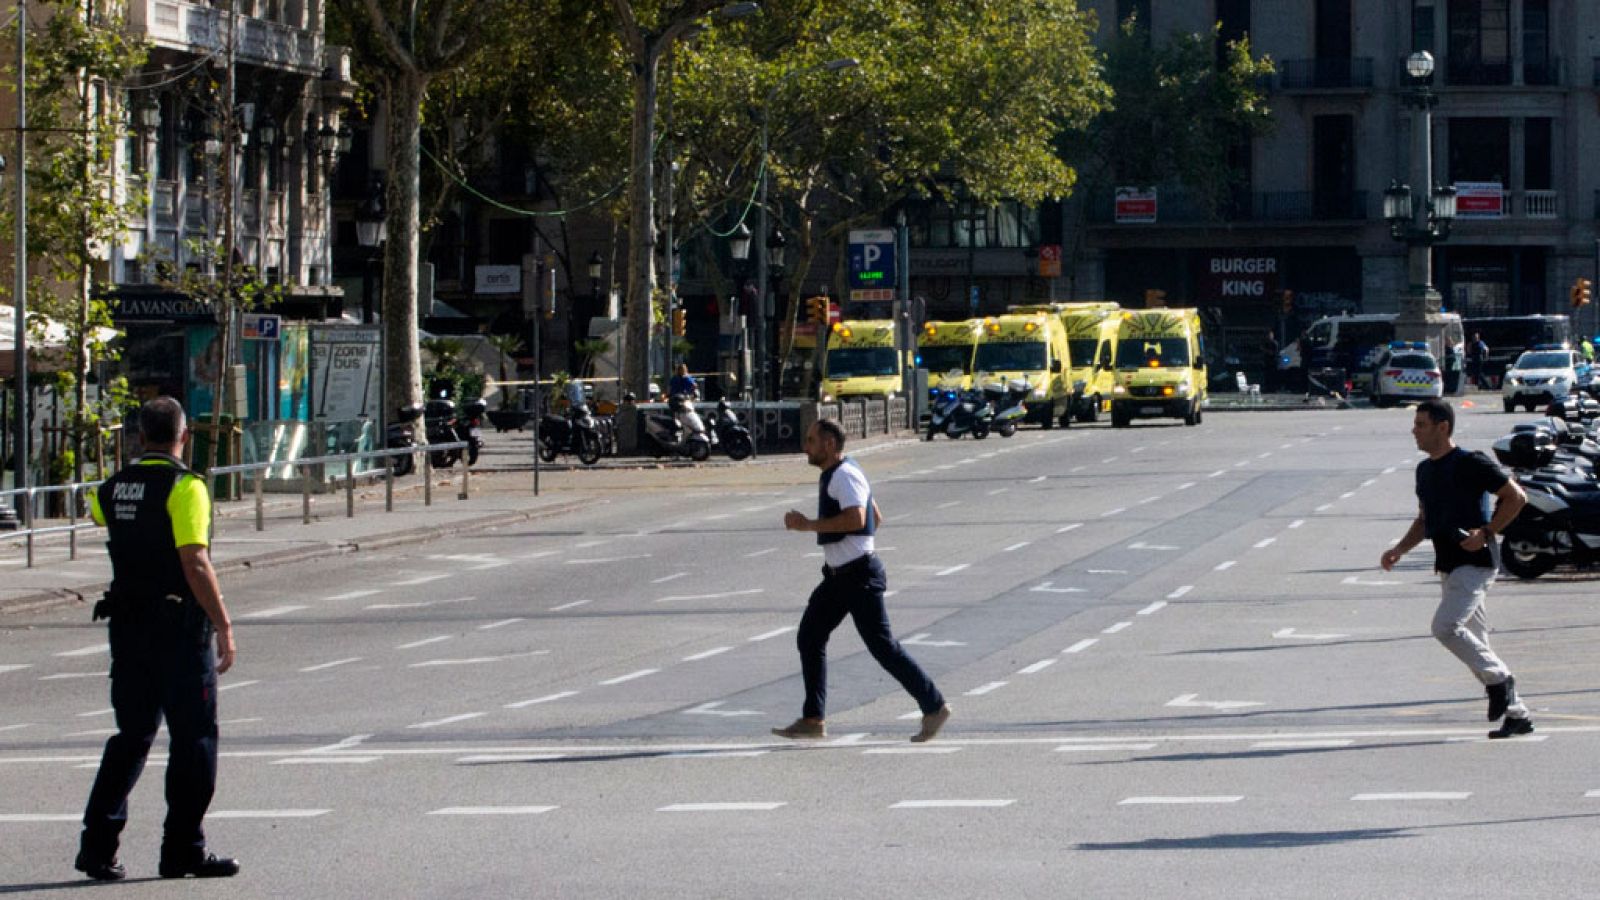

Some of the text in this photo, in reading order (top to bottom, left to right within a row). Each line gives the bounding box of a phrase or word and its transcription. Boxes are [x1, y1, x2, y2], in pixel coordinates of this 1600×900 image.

[864, 245, 881, 270] P
[1210, 257, 1276, 273] BURGER
[1221, 280, 1265, 296] KING
[263, 319, 274, 335] P
[335, 346, 367, 357] zona
[334, 358, 361, 369] bus
[112, 482, 145, 500] POLICIA
